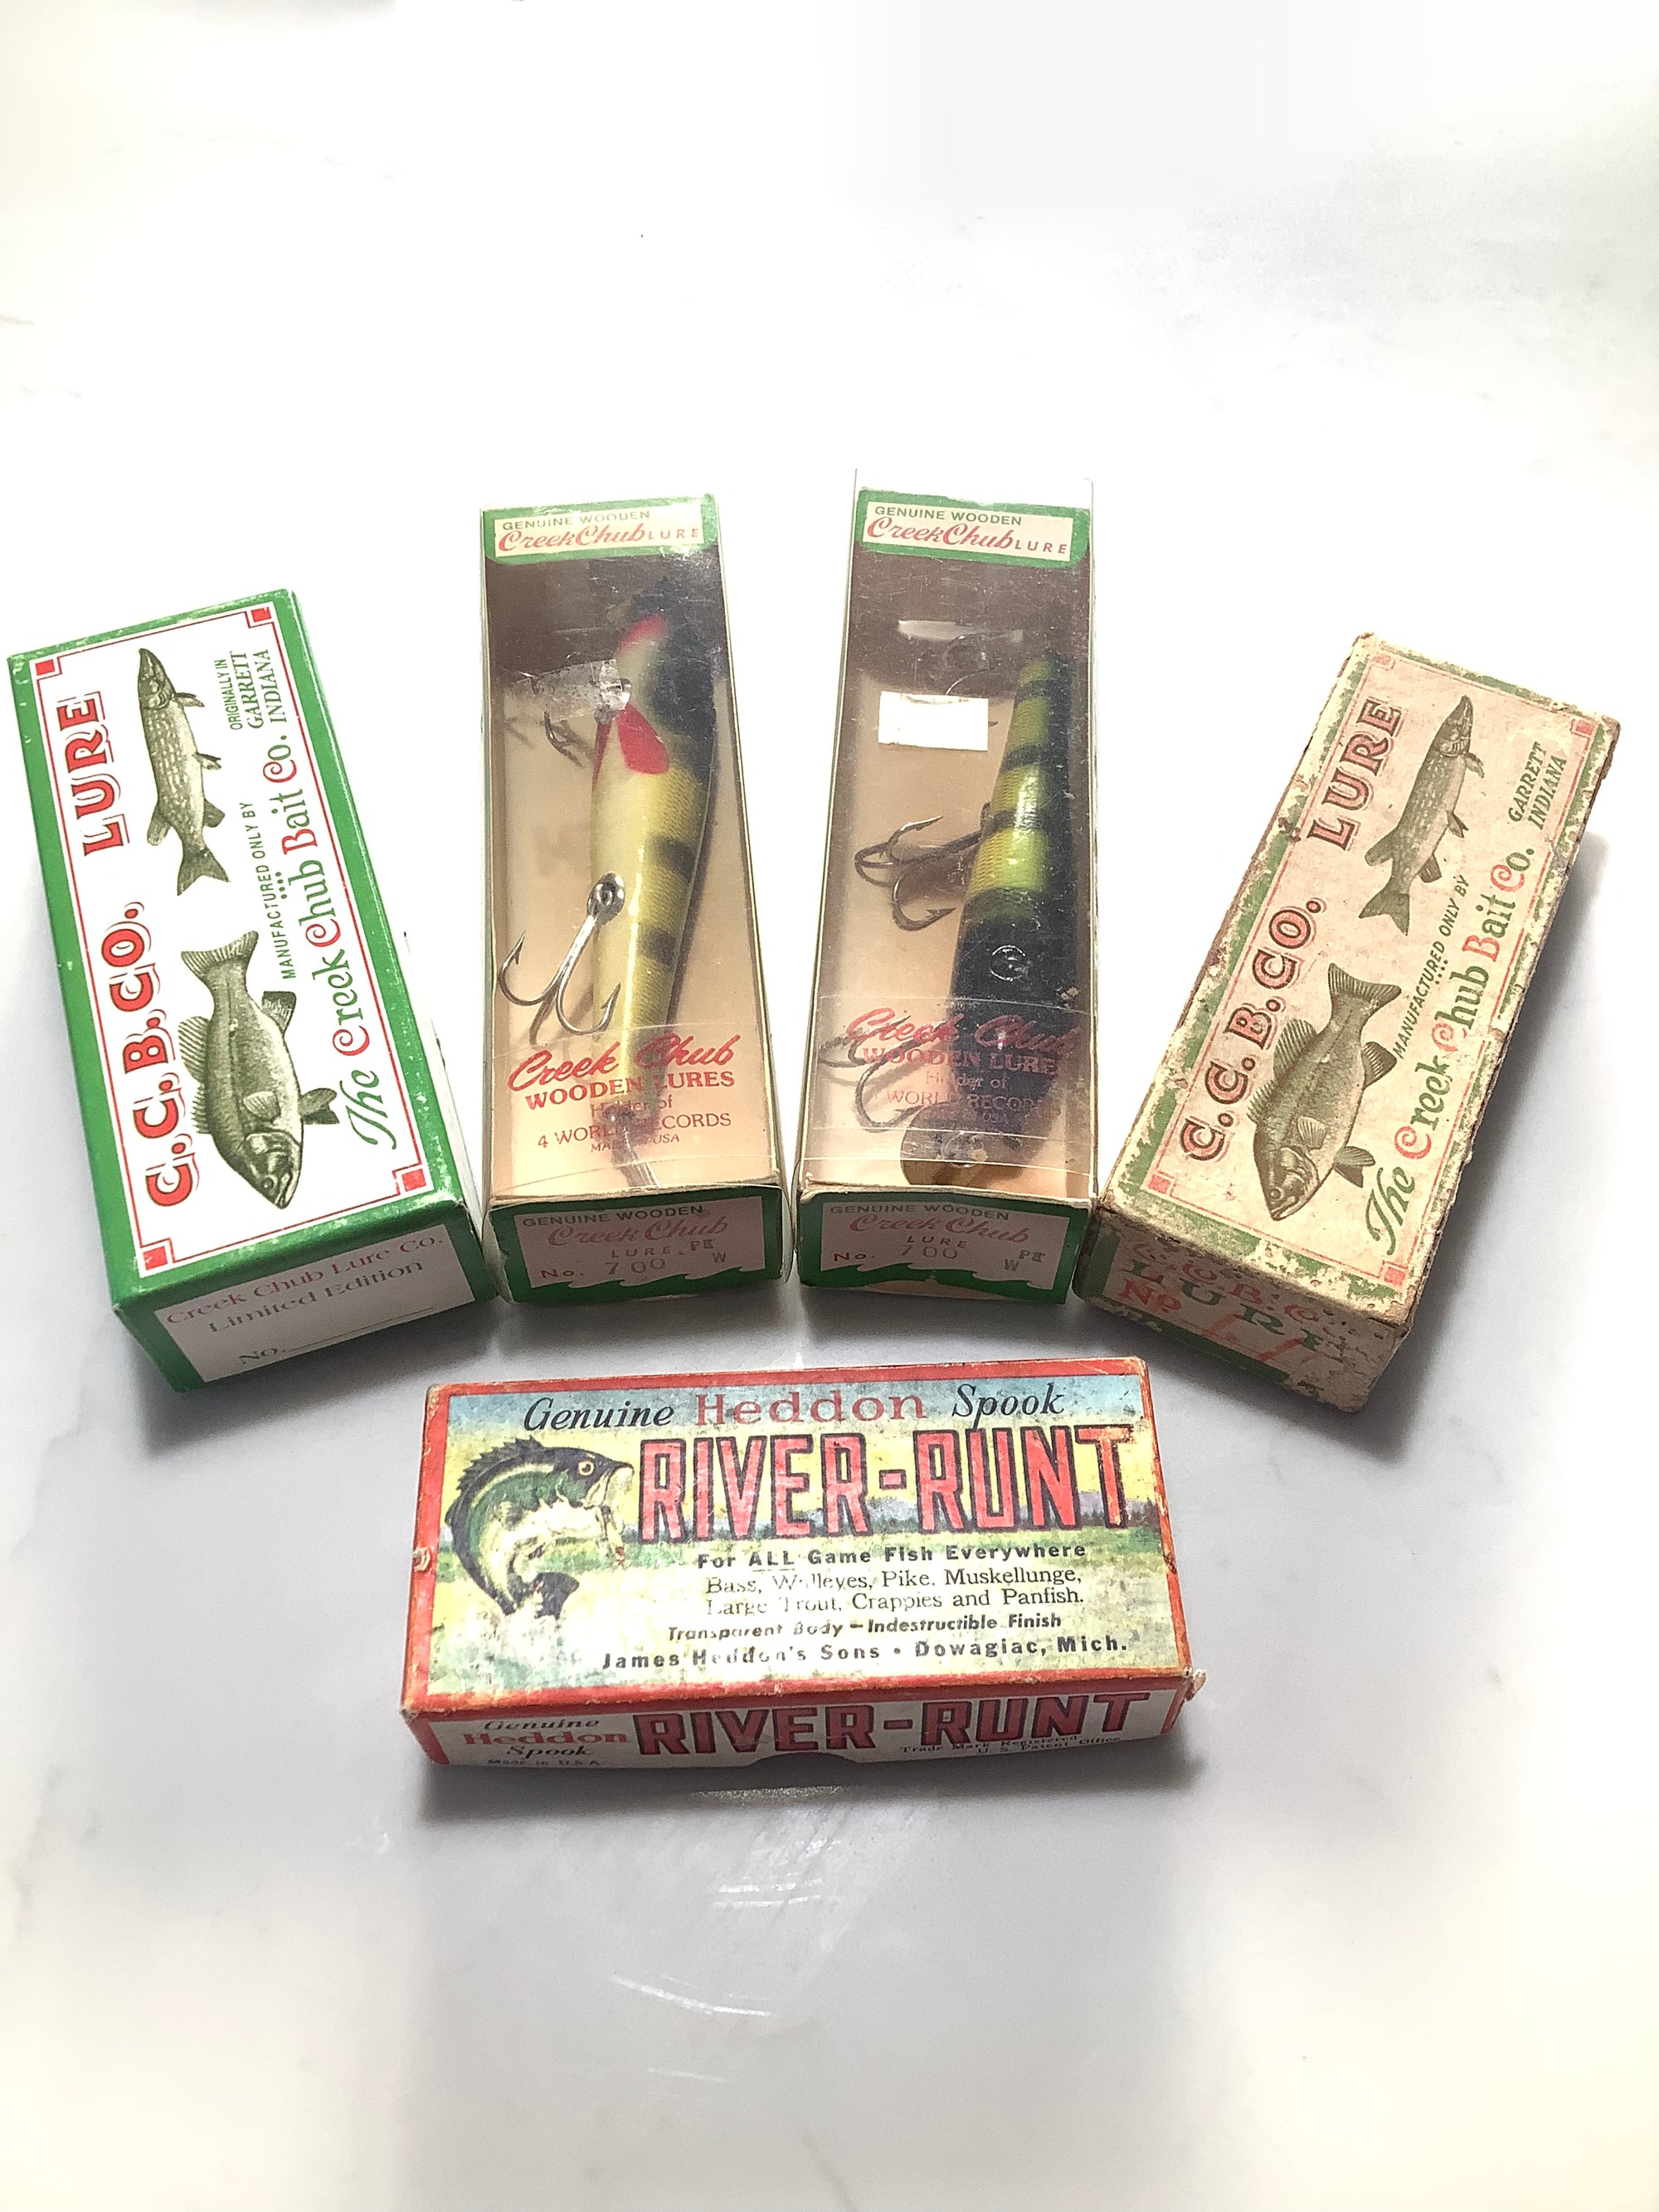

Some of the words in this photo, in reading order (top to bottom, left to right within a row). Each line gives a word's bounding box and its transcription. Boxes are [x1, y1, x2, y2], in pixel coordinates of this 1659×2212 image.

[502, 517, 573, 531] GENUINE
[874, 505, 946, 521] GENUINE
[951, 510, 1023, 527] WOODEN
[647, 527, 700, 541] LURE
[1014, 539, 1068, 555] LURE
[214, 659, 228, 669] IN
[216, 673, 243, 730] ORIGINALLY
[230, 650, 265, 729] GARRETT
[252, 649, 288, 723] INDIANA
[57, 691, 130, 857] LURE
[262, 734, 298, 784] Co.
[1306, 696, 1410, 852] LURE
[1506, 741, 1547, 824] GARRETT
[1526, 754, 1568, 831] INDIANA
[239, 802, 256, 819] BY
[268, 788, 319, 855] Bait
[246, 824, 266, 859] ONLY
[287, 859, 342, 948] Chub
[255, 864, 296, 980] MANUFACTURED
[1392, 940, 1446, 1060] MANUFACTURED
[1438, 897, 1460, 938] ONLY
[1453, 874, 1471, 897] BY
[311, 948, 371, 1057] Creek
[846, 1007, 965, 1044] Creek
[507, 1040, 621, 1092] Creek
[634, 1031, 742, 1070] Chub
[862, 1047, 981, 1069] WOODEN
[1365, 1165, 1416, 1257] The
[1394, 1054, 1453, 1160] Creek
[1430, 964, 1491, 1053] Chub
[1461, 892, 1516, 963] Bait
[1489, 847, 1535, 893] Co.
[524, 1073, 645, 1111] WOODEN
[653, 1071, 736, 1090] LURES
[658, 1094, 674, 1110] of
[338, 1069, 397, 1150] The
[537, 1135, 549, 1149] 4
[653, 1133, 680, 1145] USA
[523, 1213, 611, 1228] GENUINE
[616, 1203, 704, 1222] WOODEN
[830, 1203, 919, 1214] GENUINE
[923, 1203, 1010, 1222] WOODEN
[849, 1213, 941, 1232] Creek
[945, 1217, 1030, 1244] Chub
[547, 1224, 640, 1247] Creek
[644, 1215, 729, 1242] Chub
[906, 1235, 969, 1249] LURE
[540, 1267, 585, 1279] No.
[605, 1257, 666, 1276] 700
[611, 1246, 672, 1259] LURE
[712, 1252, 727, 1263] W
[833, 1252, 876, 1262] No.
[166, 1291, 246, 1325] Creek
[253, 1268, 324, 1298] Chub
[331, 1248, 390, 1275] Lure
[399, 1235, 443, 1253] Co.
[207, 1291, 318, 1333] Limited
[324, 1259, 425, 1297] Edition
[523, 1397, 675, 1432] Genuine
[694, 1390, 928, 1427] Heddon
[951, 1382, 1067, 1430] Spook
[637, 1423, 1135, 1546] RIVER-RUNT
[697, 1552, 737, 1569] For
[748, 1549, 795, 1568] ALL
[807, 1548, 872, 1565] Game
[883, 1545, 933, 1563] Fish
[946, 1543, 1087, 1562] Everywhere
[705, 1577, 762, 1595] Bass,
[944, 1567, 1082, 1586] Muskellunge,
[706, 1599, 767, 1616] Large
[851, 1591, 943, 1612] Crappies
[952, 1590, 990, 1607] and
[1001, 1587, 1085, 1606] Panfish.
[668, 1624, 783, 1641] Transparent
[793, 1619, 844, 1638] Body
[1008, 1612, 1062, 1629] Finish
[603, 1652, 680, 1670] James
[820, 1644, 881, 1661] Sons
[914, 1637, 1048, 1659] Dowagiac,
[1056, 1634, 1128, 1654] Mich.
[463, 1731, 629, 1745] Heddon
[484, 1718, 601, 1731] Genuine
[631, 1692, 1151, 1757] RIVER-RUNT
[505, 1745, 596, 1759] Spook
